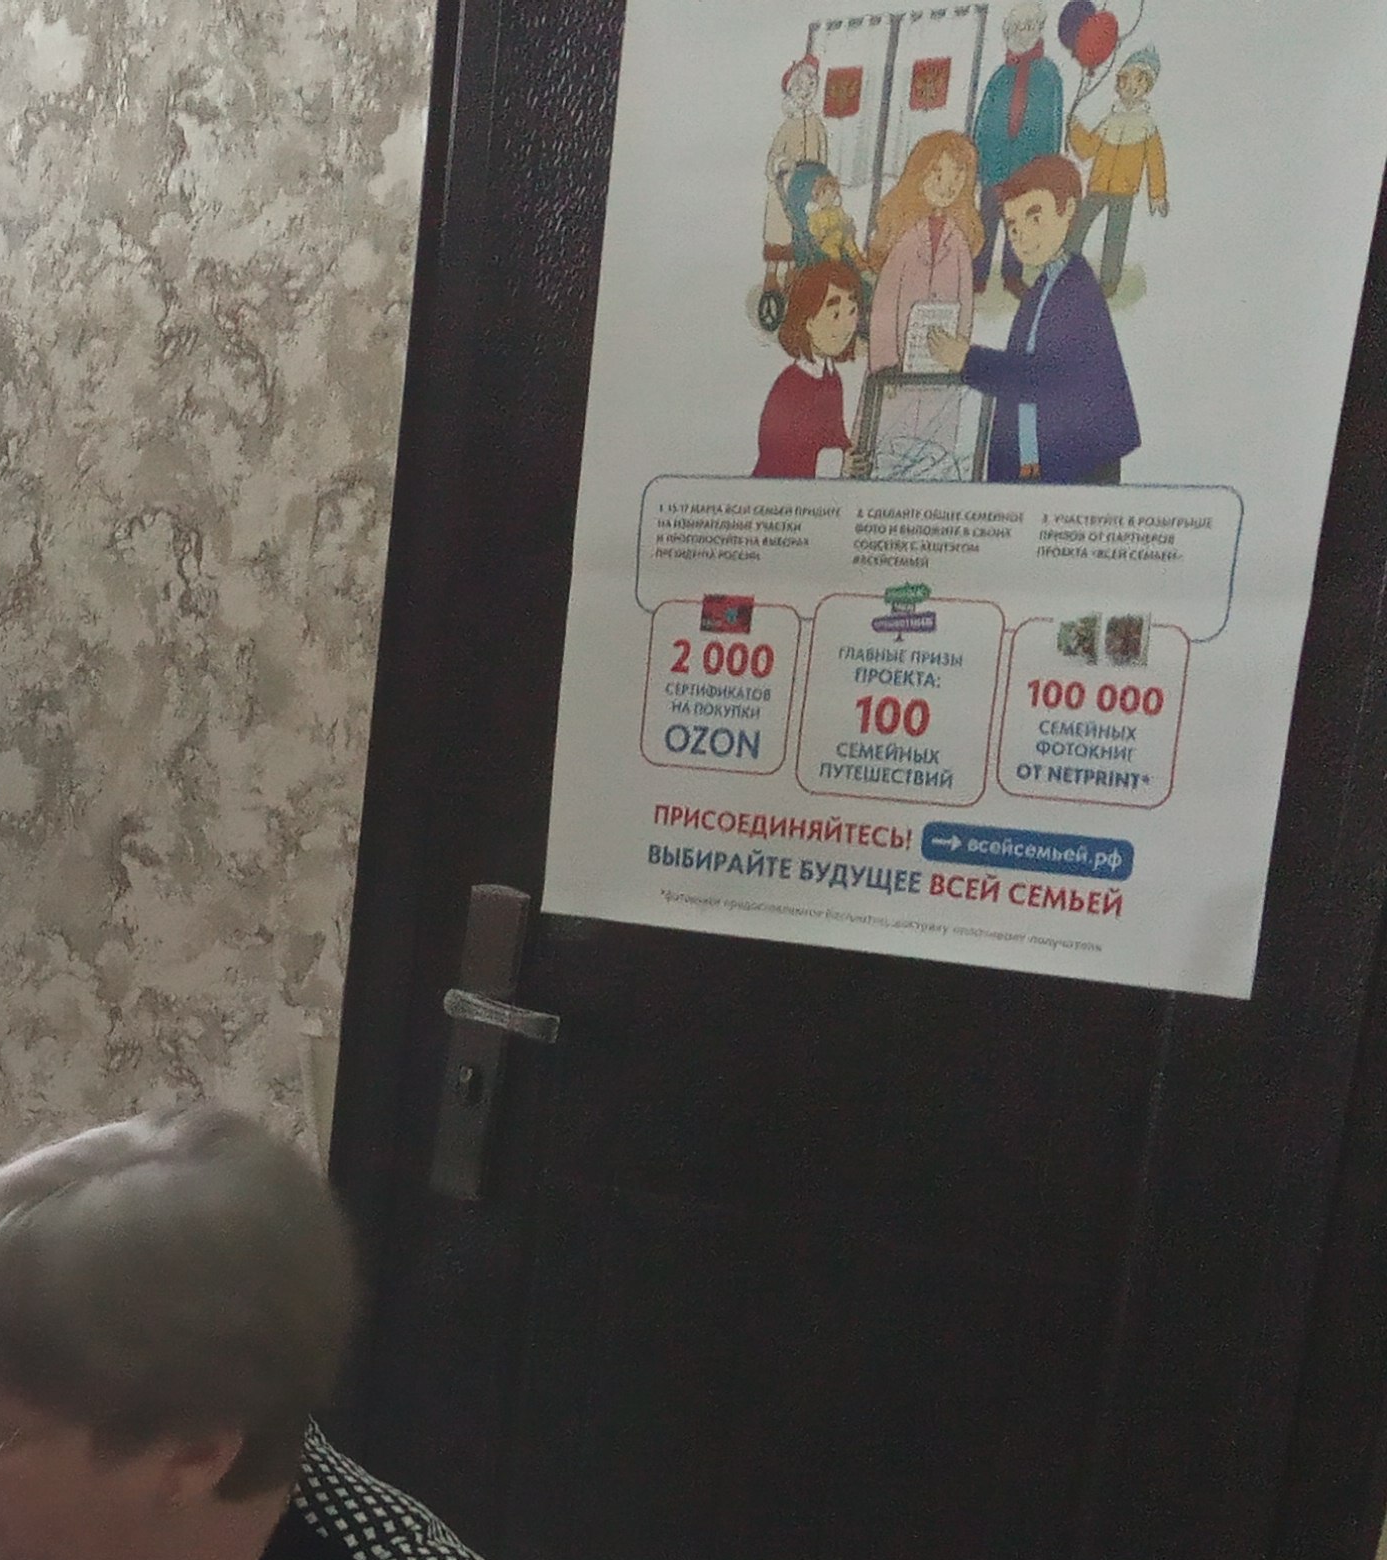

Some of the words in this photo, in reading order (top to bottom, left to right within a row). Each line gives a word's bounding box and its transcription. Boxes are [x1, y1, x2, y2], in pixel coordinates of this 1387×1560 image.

[670, 639, 691, 674] 2
[702, 640, 775, 678] 000
[838, 646, 906, 665] ГЛАВНЫЕ
[911, 650, 963, 667] ПРИЗЫ
[855, 668, 941, 688] ПРОЕКТА:
[665, 682, 771, 701] СЕРТИФИКАТОВ
[1028, 679, 1086, 710] 100
[1097, 683, 1164, 716] 000
[671, 701, 690, 715] НА
[694, 702, 761, 719] ПОКУПКИ
[856, 695, 931, 737] 100
[664, 724, 761, 759] OZON
[1039, 719, 1137, 740] СЕМЕЙНЫХ
[836, 741, 940, 765] СЕМЕЙНЫХ
[1036, 740, 1134, 762] ФОТОКНИГ
[819, 762, 955, 789] ПУТЕШЕСТВИЙ
[1016, 763, 1042, 780] ОТ
[653, 804, 913, 850] ПРИСОЕДИНЯЙТЕСЬ!
[967, 837, 1123, 871] всейсемьей.рф
[648, 843, 792, 879] ВЫБИРАЙТЕ
[798, 859, 922, 895] БУДУЩЕЕ
[929, 872, 1000, 902] ВСЕЙ
[1008, 881, 1124, 919] СЕМЬЕЙ
